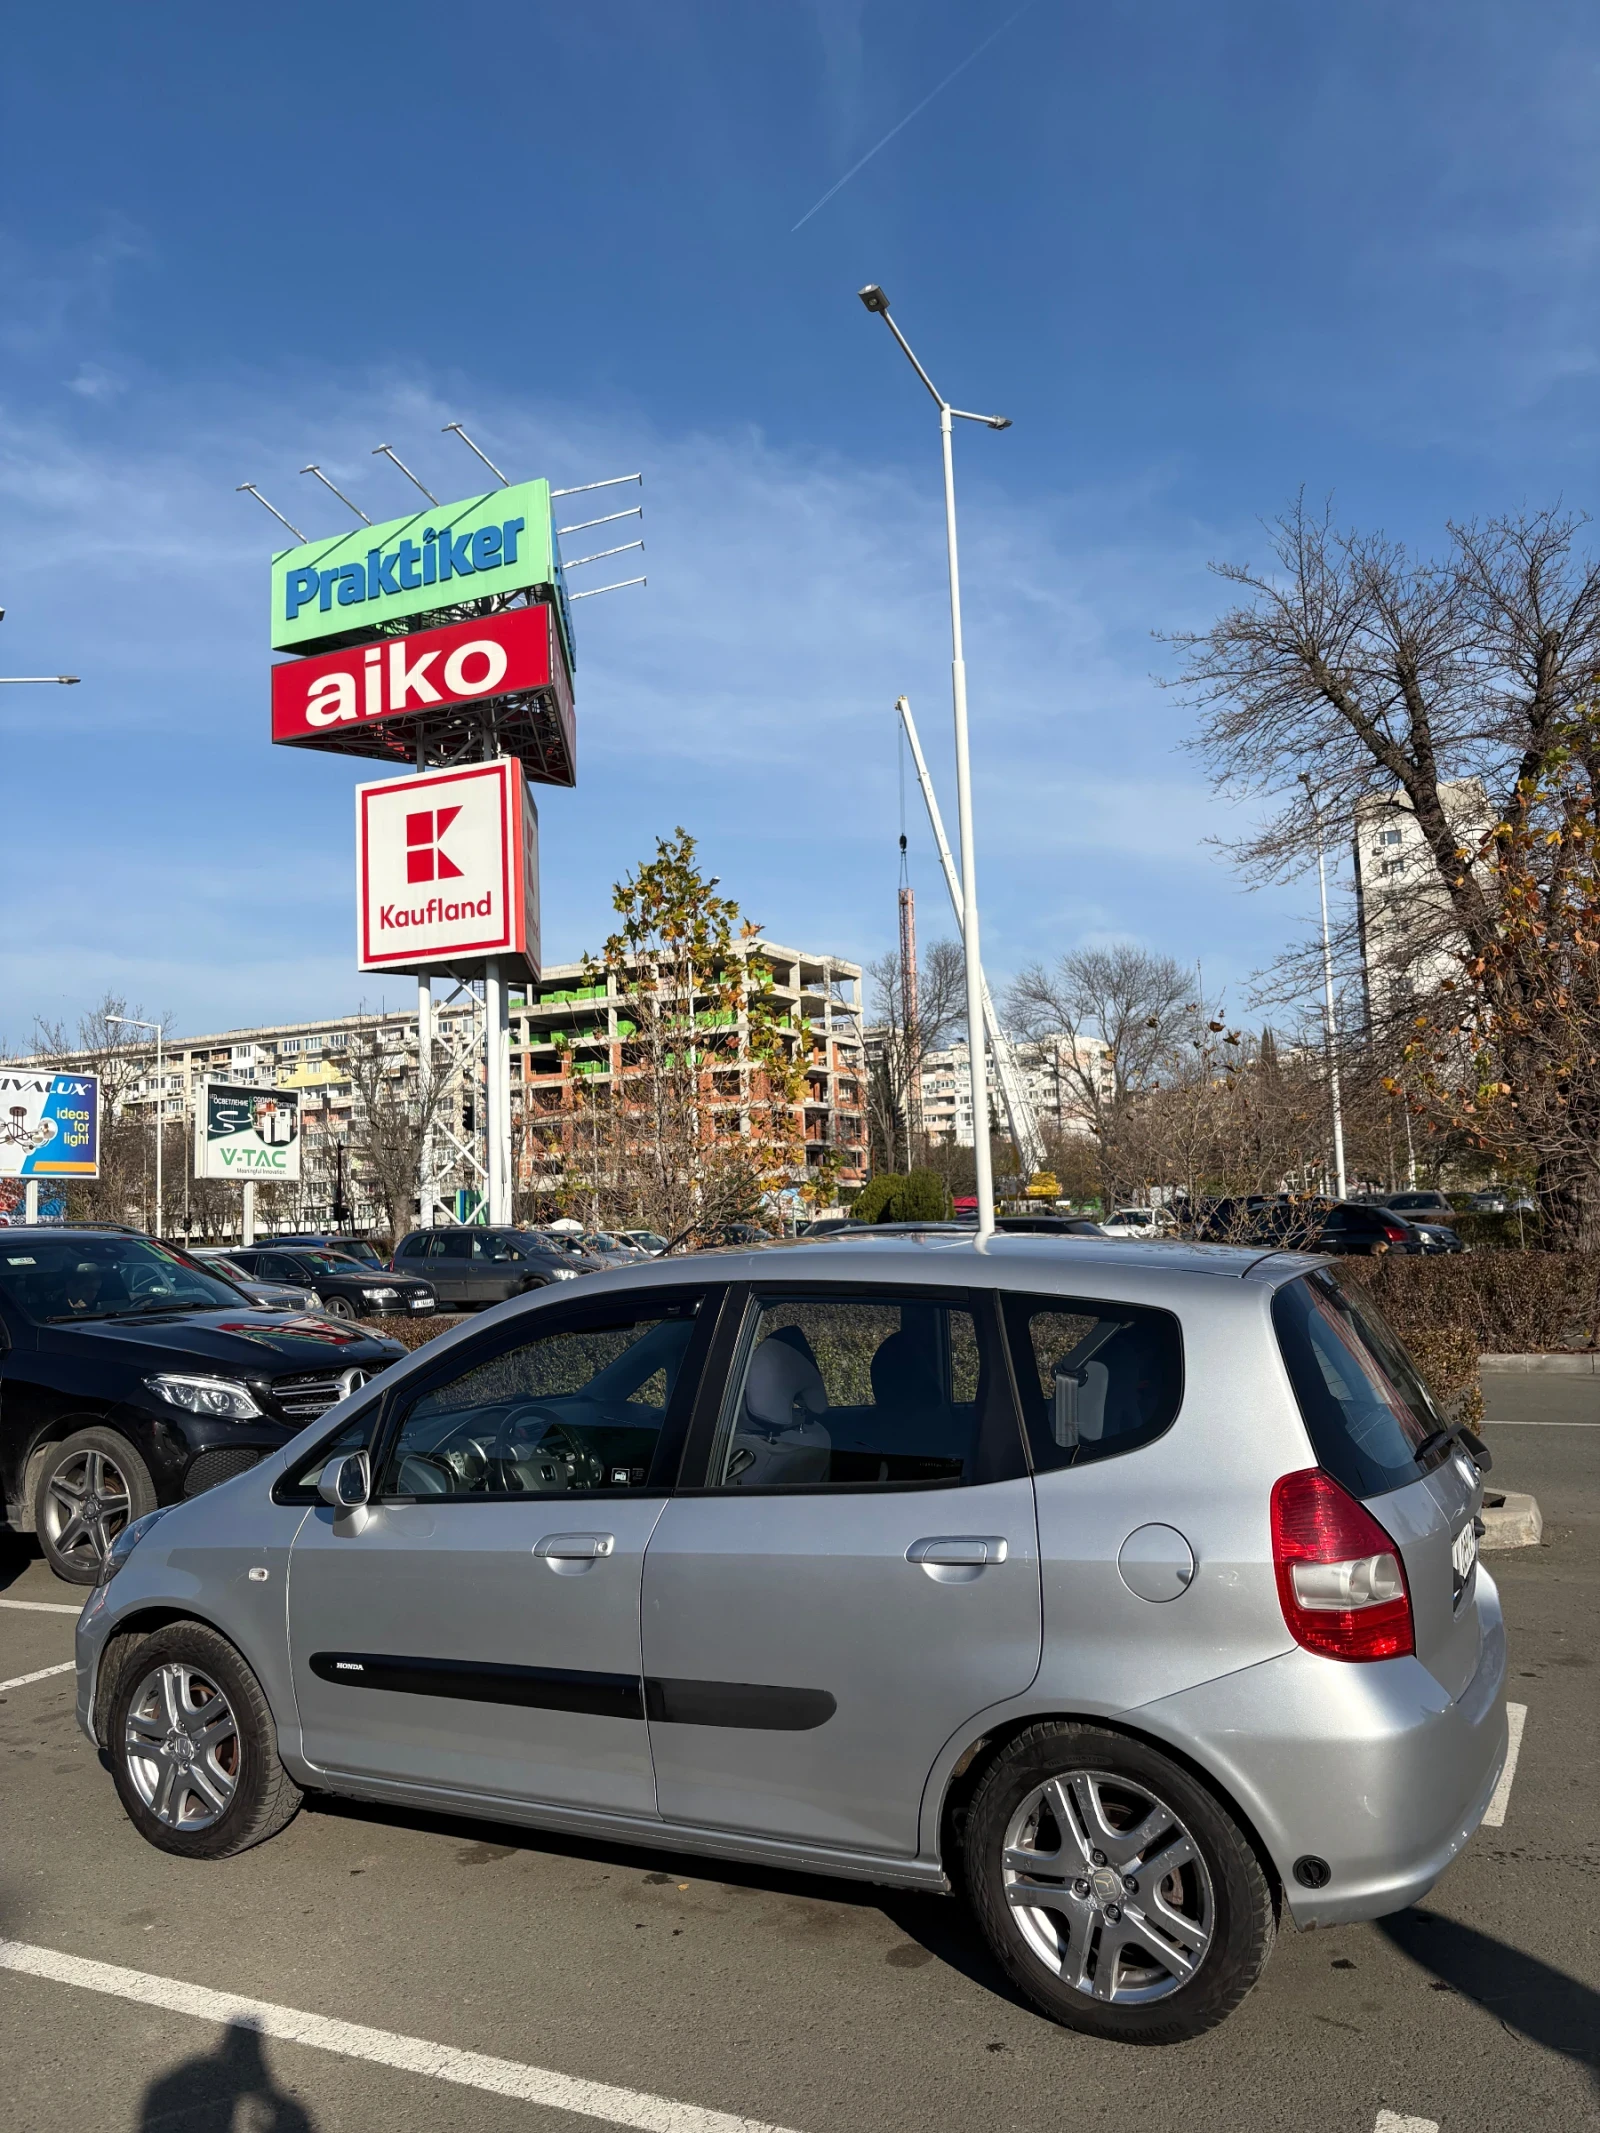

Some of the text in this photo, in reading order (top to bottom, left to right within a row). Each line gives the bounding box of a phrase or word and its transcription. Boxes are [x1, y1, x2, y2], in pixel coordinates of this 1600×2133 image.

[285, 516, 525, 620] Praktiker
[304, 639, 508, 727] aiko
[379, 891, 492, 930] Kaufland
[56, 1107, 89, 1120] ideas
[74, 1121, 89, 1132] for
[63, 1132, 89, 1147] light
[220, 1148, 286, 1168] V-TAC
[336, 1662, 364, 1670] HONDA
